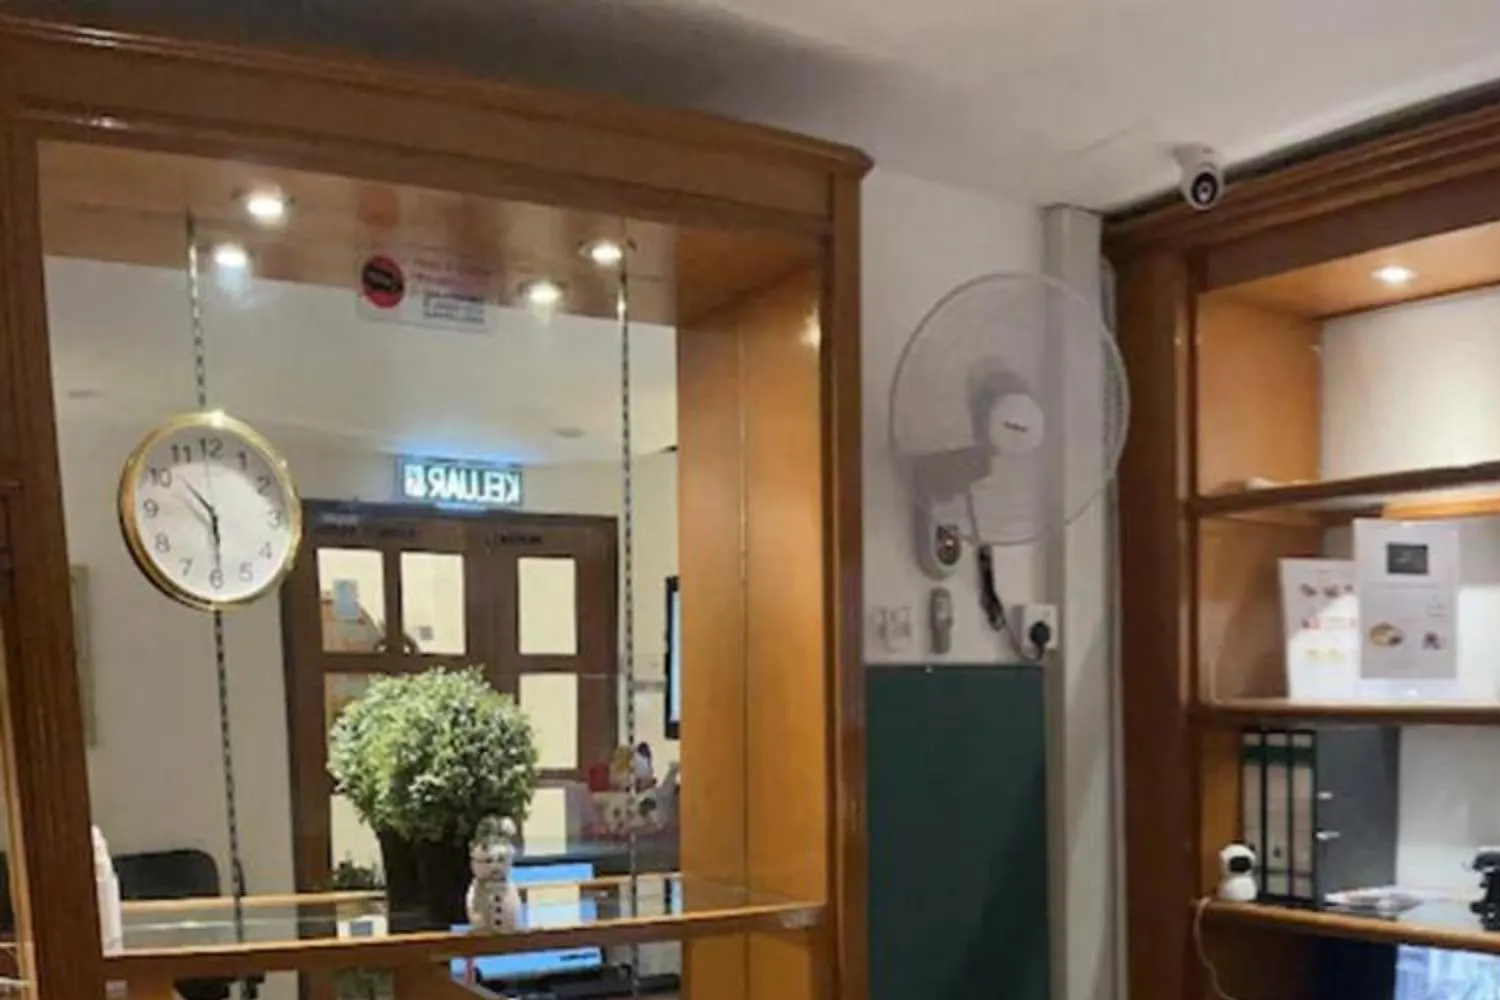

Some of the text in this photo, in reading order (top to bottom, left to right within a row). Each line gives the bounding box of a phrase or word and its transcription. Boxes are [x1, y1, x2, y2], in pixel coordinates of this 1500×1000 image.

[172, 444, 192, 463] 11
[200, 437, 223, 459] 12
[238, 451, 248, 469] 1
[150, 467, 172, 488] 10
[257, 475, 270, 494] 2
[143, 498, 159, 518] 9
[267, 509, 281, 528] 3
[155, 532, 171, 553] 8
[259, 541, 273, 559] 4
[180, 558, 192, 577] 7
[239, 561, 253, 582] 5
[209, 568, 224, 589] 6
